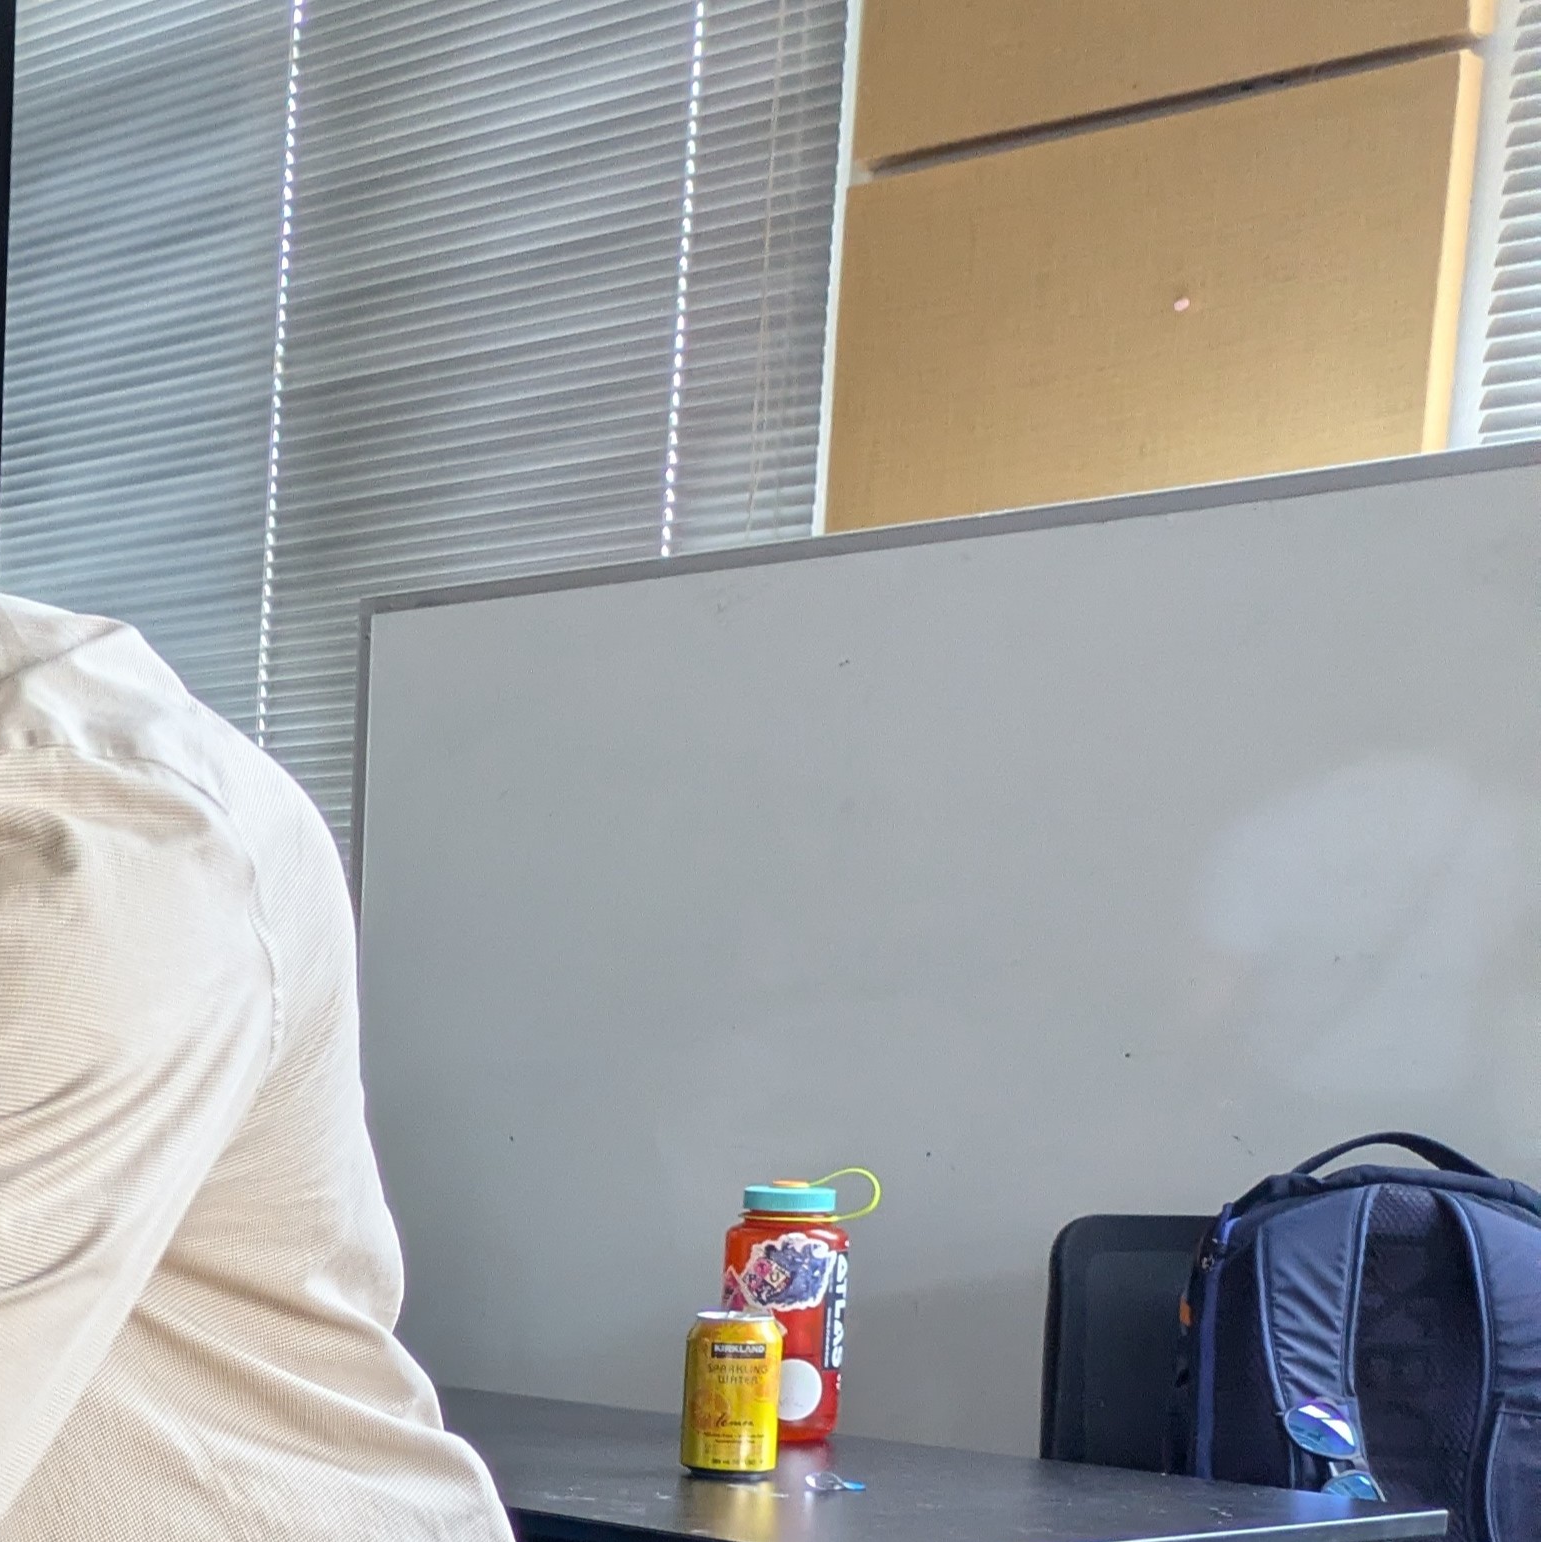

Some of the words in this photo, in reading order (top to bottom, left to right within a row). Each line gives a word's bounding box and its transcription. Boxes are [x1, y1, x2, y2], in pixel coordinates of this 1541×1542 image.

[831, 1254, 849, 1369] ATLAS
[713, 1344, 765, 1353] KIRKLAND
[708, 1362, 769, 1375] SPARKLING
[718, 1375, 759, 1385] WATER
